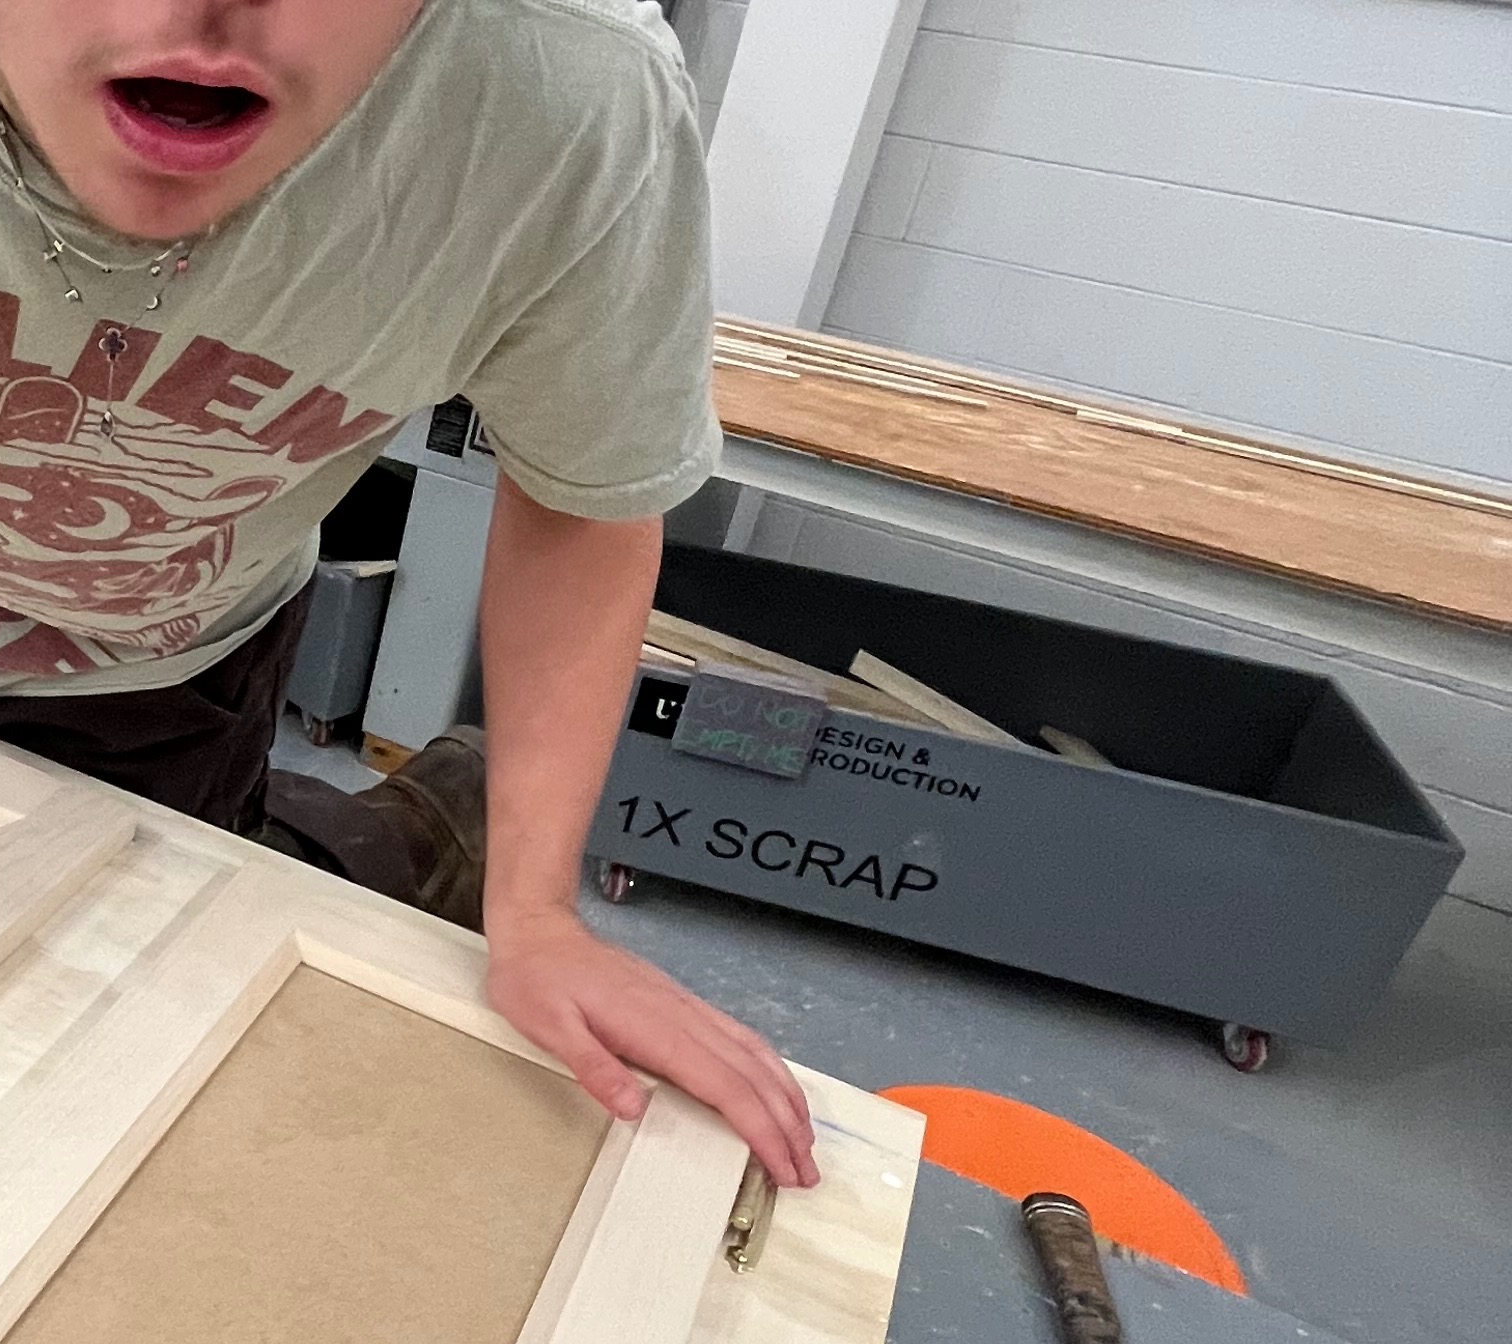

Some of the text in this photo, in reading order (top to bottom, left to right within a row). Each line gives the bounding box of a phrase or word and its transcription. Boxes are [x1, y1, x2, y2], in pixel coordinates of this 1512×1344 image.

[815, 726, 930, 766] ESIGN &
[810, 748, 981, 802] RODUCTION
[618, 796, 938, 901] 1X SCRAP
